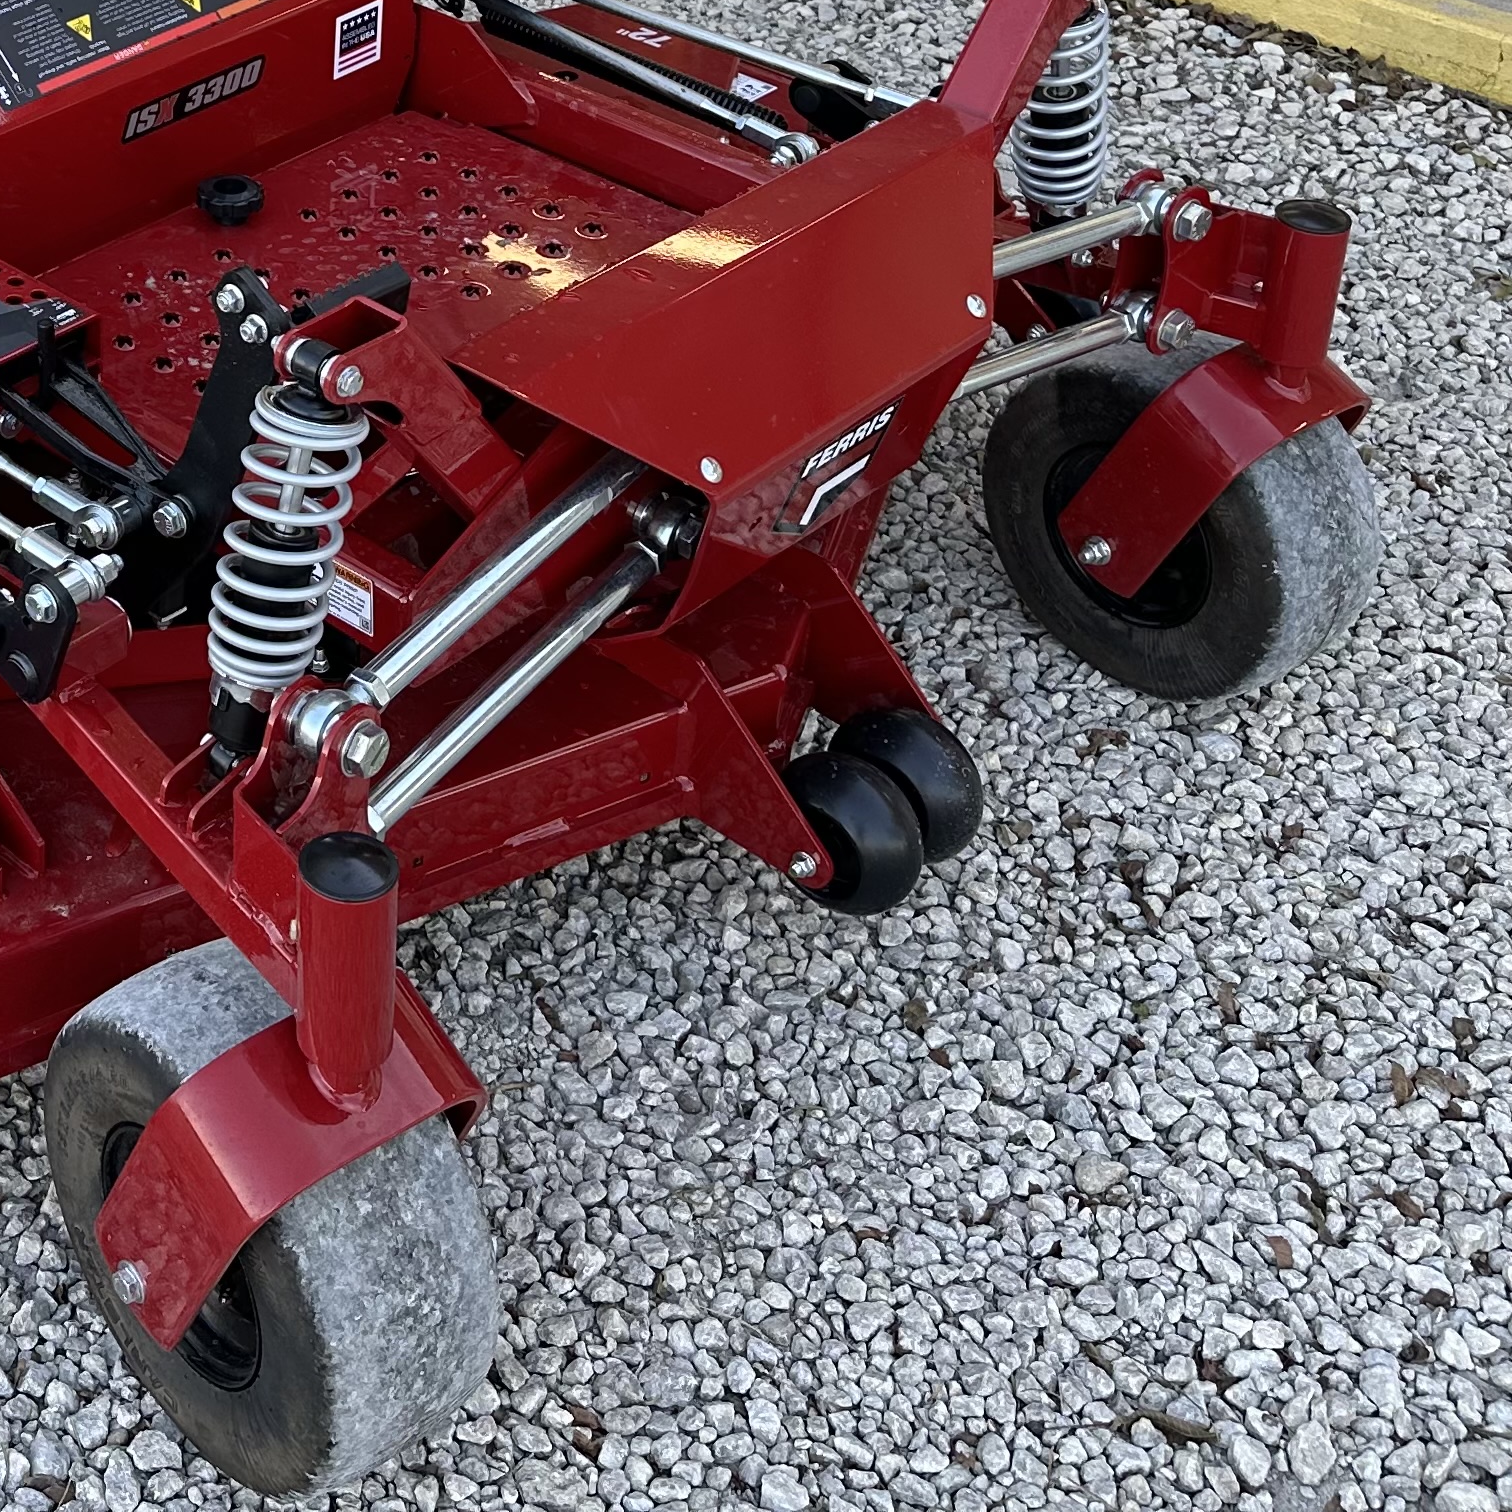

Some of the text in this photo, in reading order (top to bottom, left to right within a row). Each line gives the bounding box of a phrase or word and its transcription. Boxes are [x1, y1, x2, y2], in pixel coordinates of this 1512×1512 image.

[124, 58, 263, 140] ISX 3300
[801, 405, 895, 479] FERRIS
